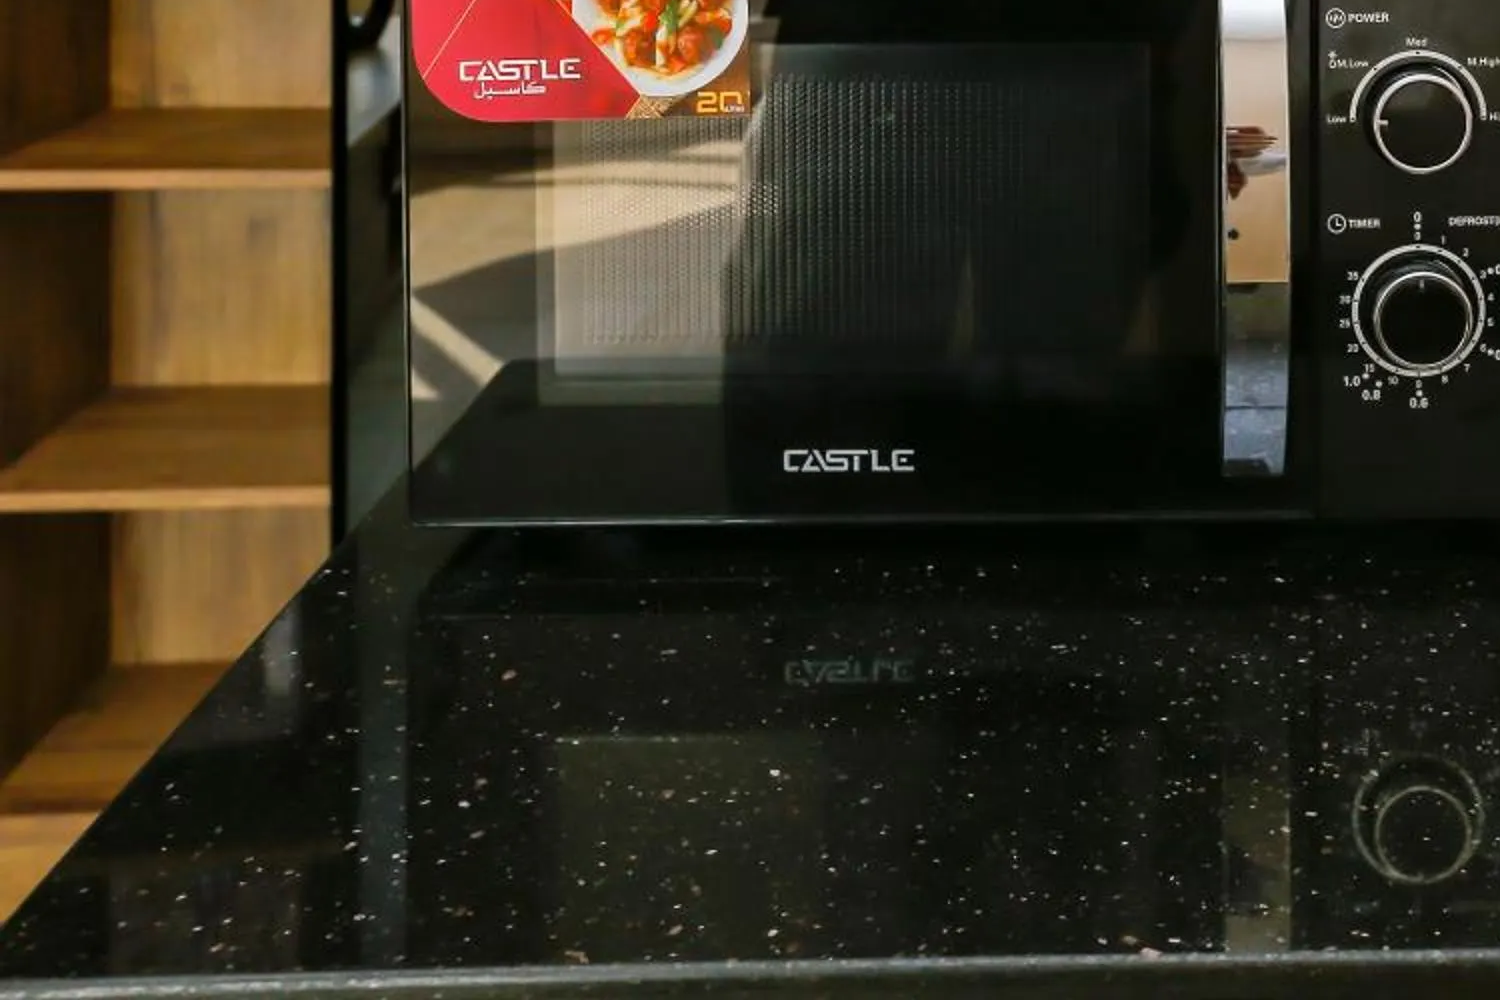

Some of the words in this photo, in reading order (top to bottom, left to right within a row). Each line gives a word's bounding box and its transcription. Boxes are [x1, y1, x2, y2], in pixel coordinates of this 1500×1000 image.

[1347, 12, 1390, 23] POWER
[1405, 37, 1428, 48] Med
[459, 58, 581, 82] CASTLE
[697, 91, 742, 113] 20
[1326, 113, 1347, 123] Low
[1413, 210, 1422, 223] 0
[1348, 219, 1381, 229] TIMER
[1343, 375, 1361, 387] 1.0
[1361, 389, 1381, 401] 0.8
[1409, 397, 1429, 409] 0.6
[783, 449, 915, 472] CASTLE
